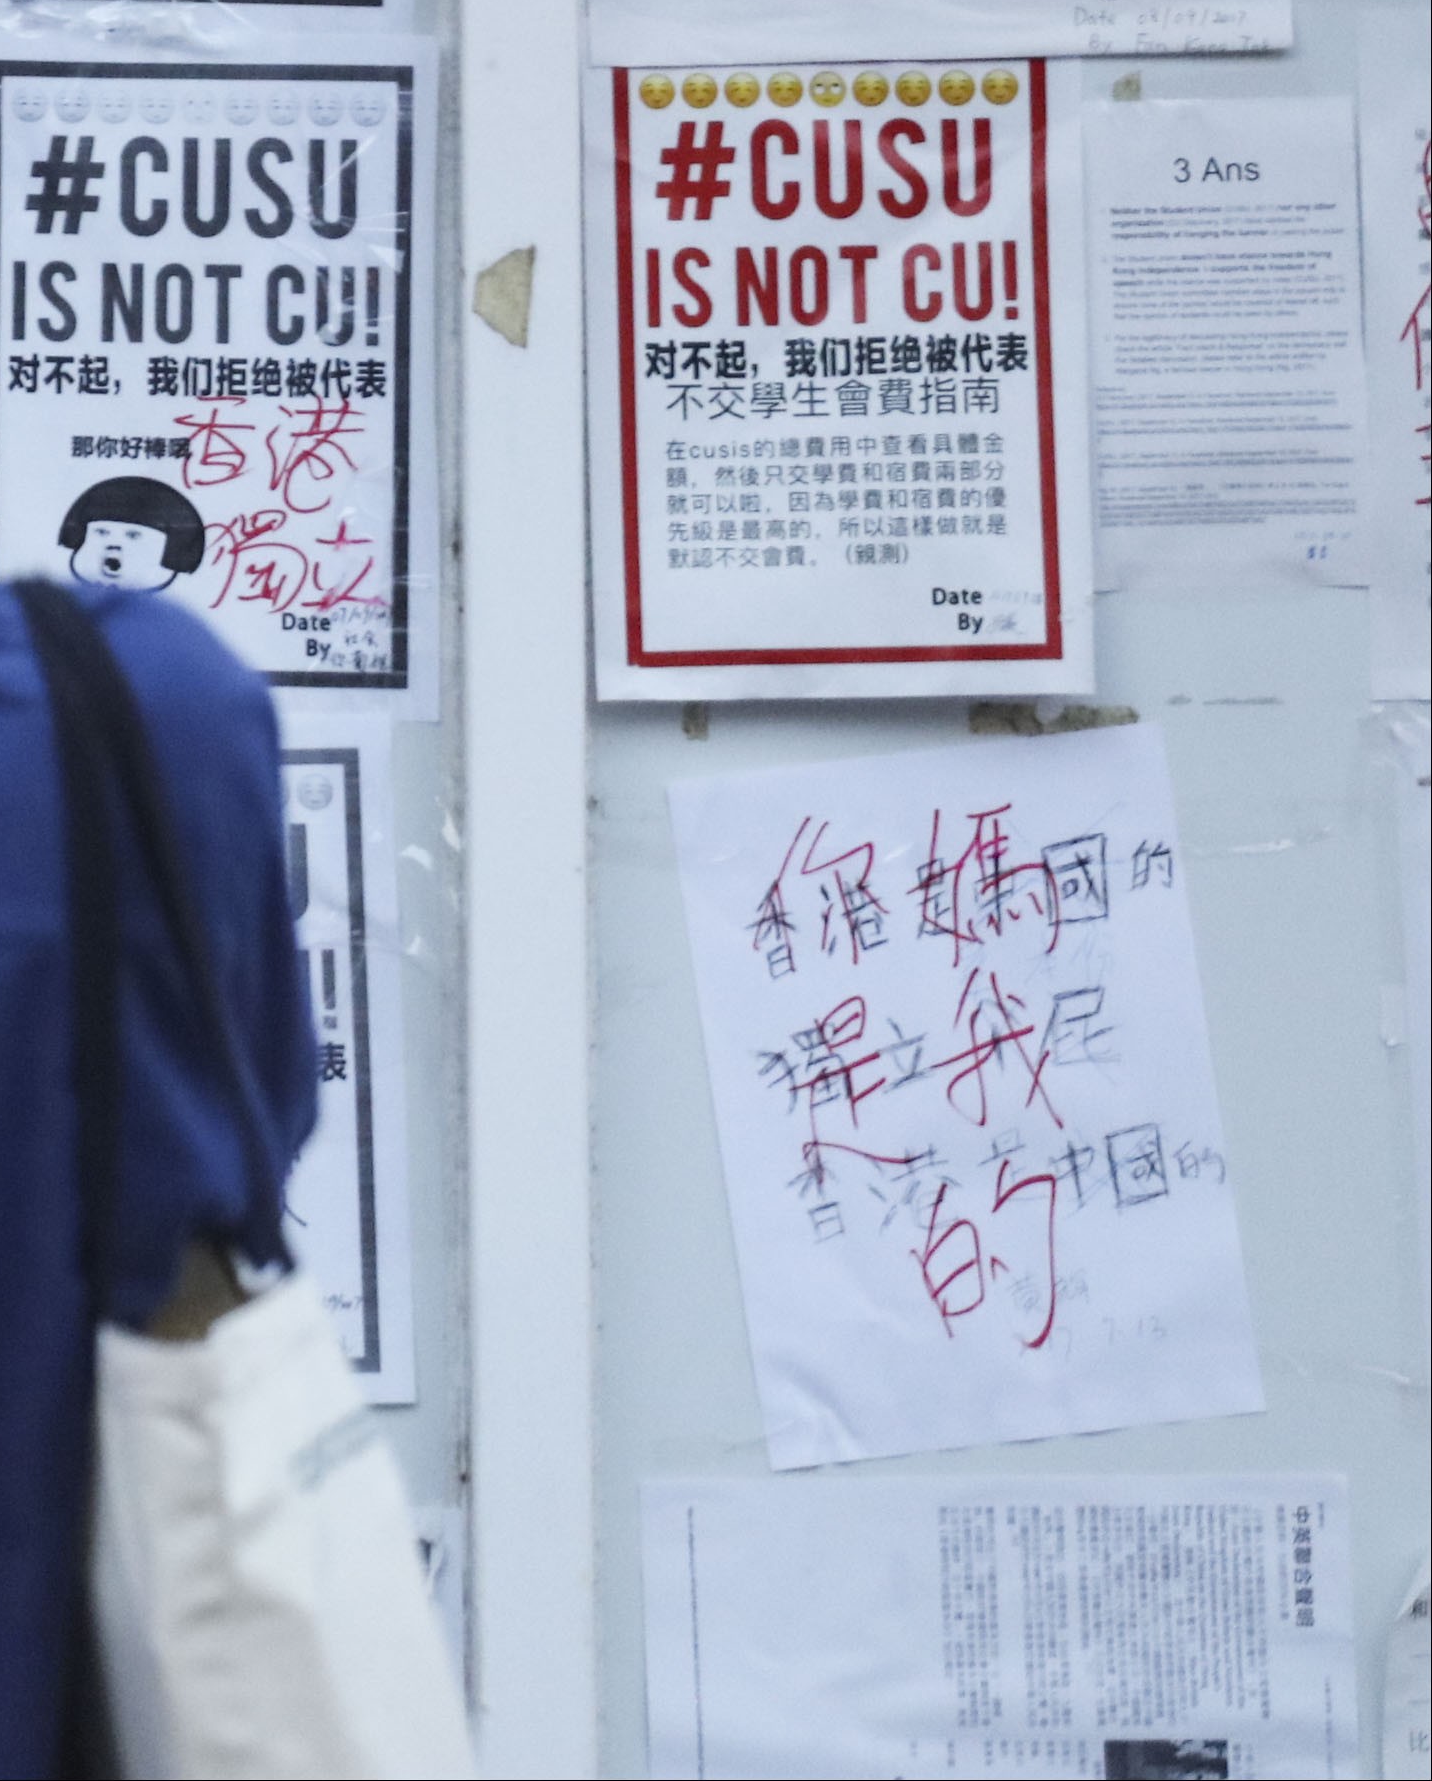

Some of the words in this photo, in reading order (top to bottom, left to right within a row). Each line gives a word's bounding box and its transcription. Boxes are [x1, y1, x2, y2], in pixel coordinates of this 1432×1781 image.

[26, 136, 358, 238] #CUSU
[655, 117, 994, 222] #CUSU
[1174, 157, 1191, 182] 3
[1202, 157, 1260, 182] Ans
[12, 260, 77, 344] IS
[101, 262, 242, 345] NOT
[266, 265, 381, 346] CU!
[646, 246, 714, 329] IS
[735, 244, 880, 327] NOT
[901, 240, 1020, 323] CU!
[9, 353, 387, 399] 对不起，我们拒绝被代表
[646, 333, 1029, 380] 对不起，我们拒绝被代表
[666, 376, 1000, 420] 不交學生會費指南
[174, 397, 367, 514] 香港
[933, 588, 981, 605] Date
[281, 613, 332, 632] Date
[958, 614, 982, 634] By
[306, 640, 331, 662] By
[910, 1159, 1056, 1349] 的
